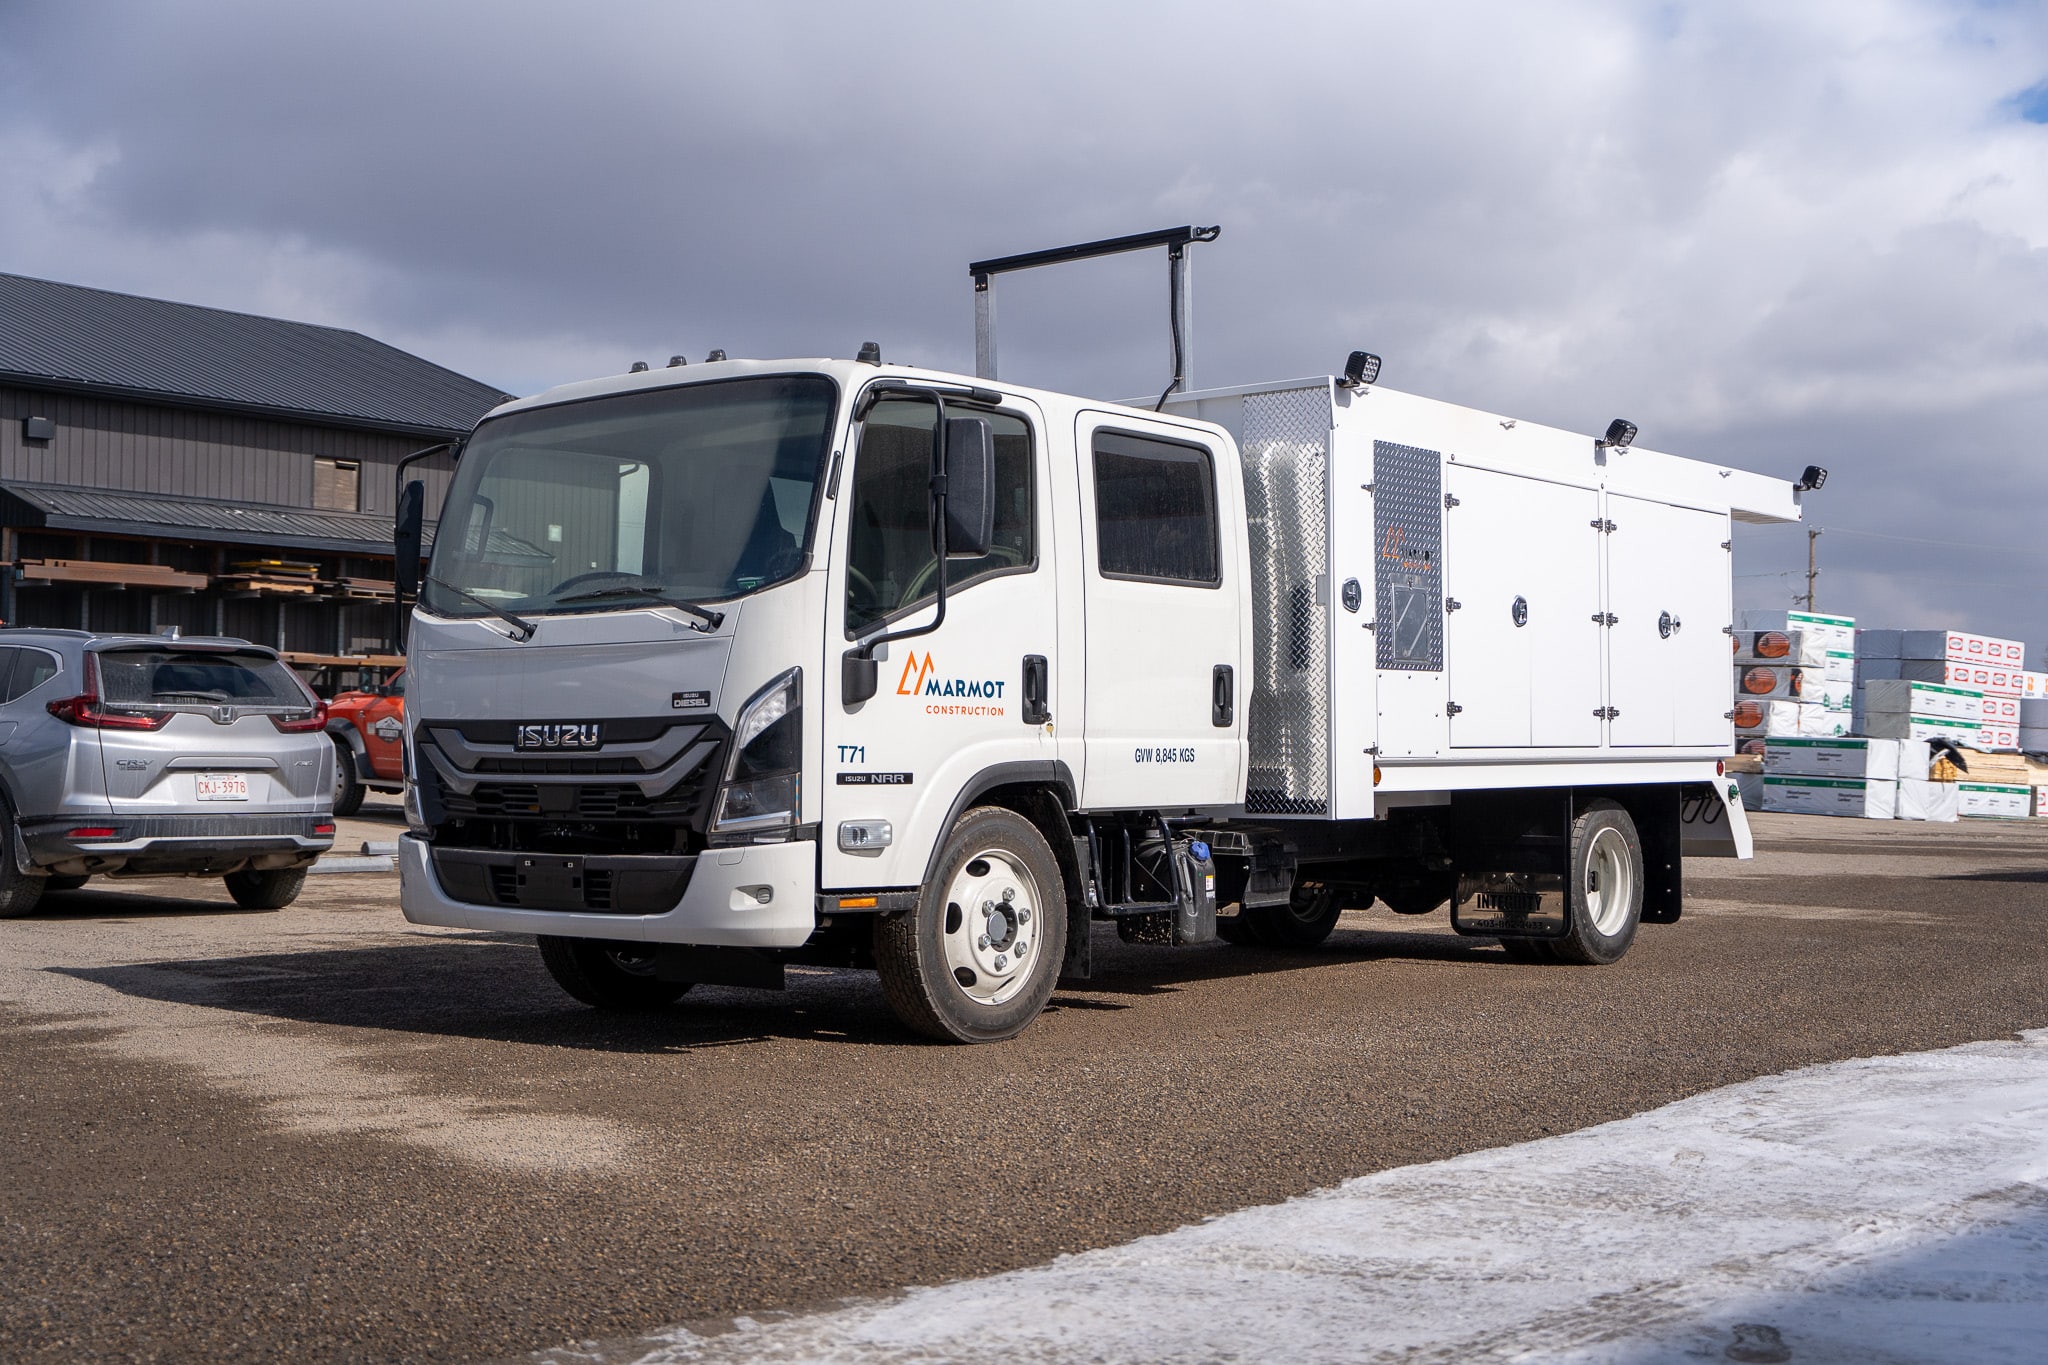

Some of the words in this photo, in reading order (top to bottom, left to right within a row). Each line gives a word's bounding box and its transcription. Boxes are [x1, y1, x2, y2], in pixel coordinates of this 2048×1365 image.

[925, 679, 1005, 698] MARMOT
[674, 698, 709, 707] DIESEL
[925, 705, 1004, 716] CONSTRUCTION
[517, 724, 599, 747] ISUZU
[837, 745, 865, 763] T71
[1135, 748, 1153, 763] GVW
[1155, 748, 1177, 765] 8,845
[1179, 748, 1195, 763] KGS
[871, 774, 905, 783] NRR
[198, 781, 246, 794] CKJ-3978
